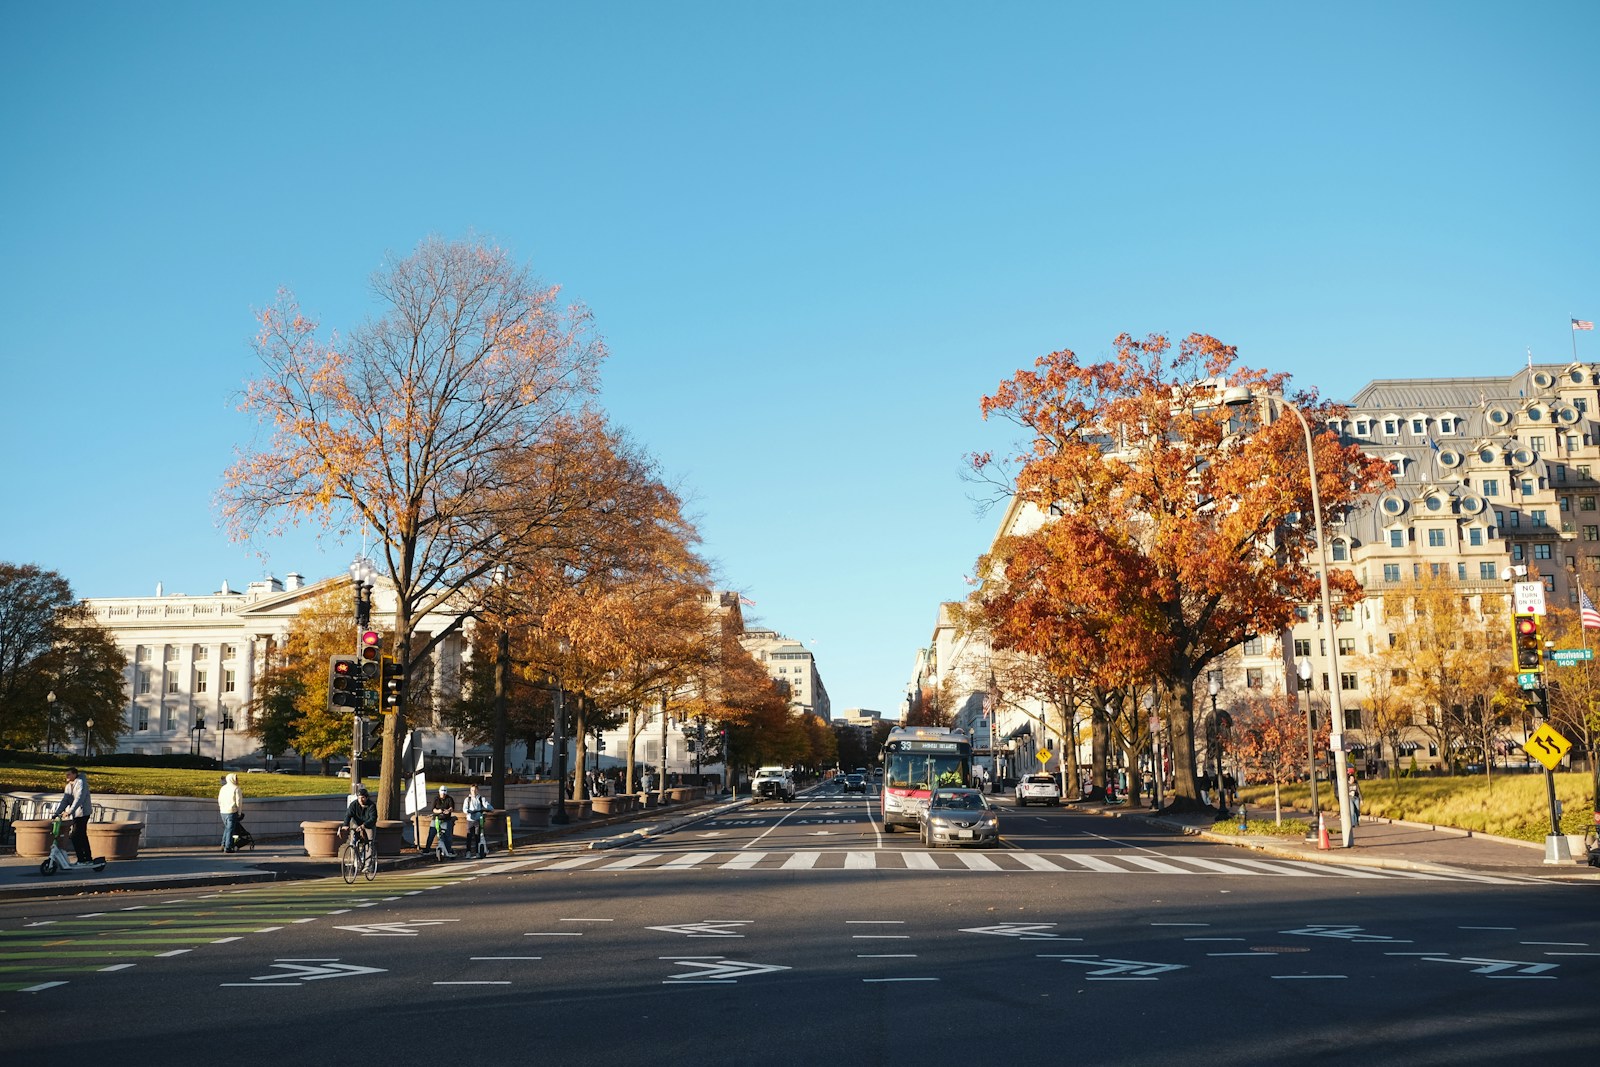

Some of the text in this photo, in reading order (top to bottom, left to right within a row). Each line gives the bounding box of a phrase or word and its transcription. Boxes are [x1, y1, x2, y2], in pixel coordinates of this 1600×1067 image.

[1520, 674, 1528, 684] 15
[364, 690, 371, 699] 15
[900, 741, 912, 750] 33
